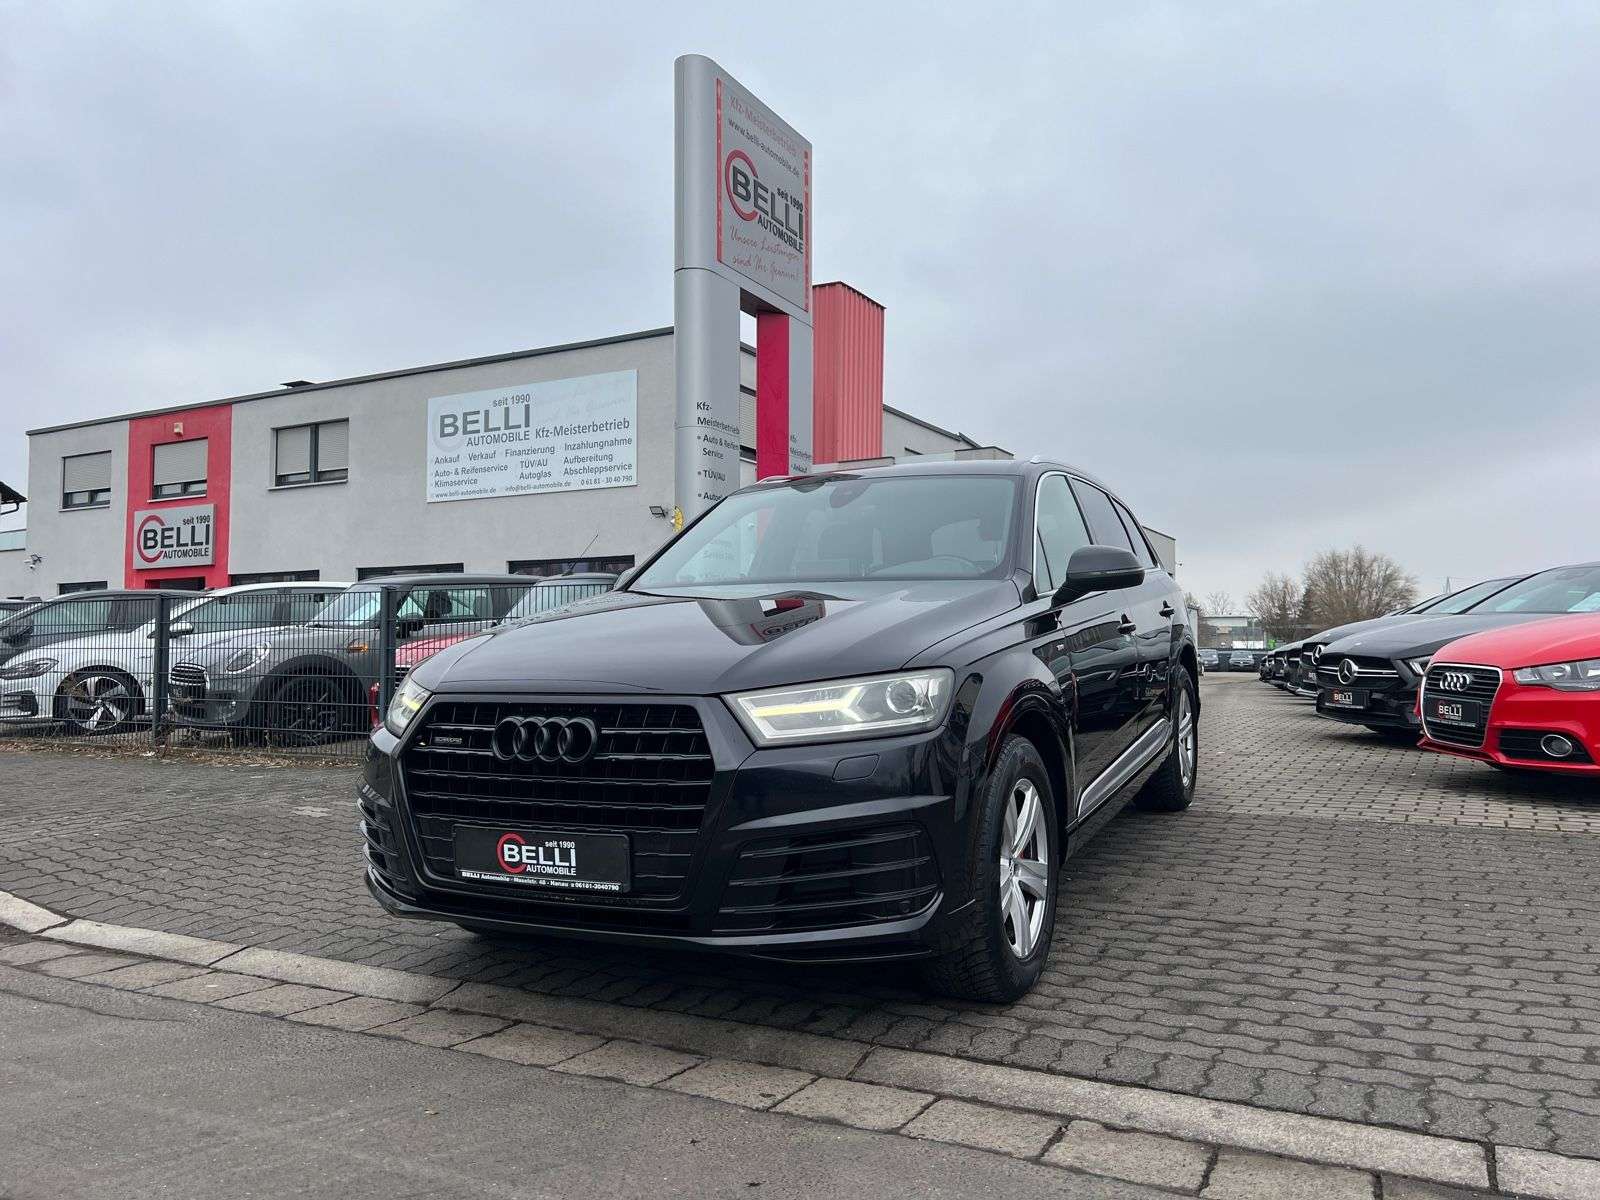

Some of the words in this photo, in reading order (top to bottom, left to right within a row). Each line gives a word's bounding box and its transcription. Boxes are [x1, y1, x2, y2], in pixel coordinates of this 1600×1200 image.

[732, 165, 804, 241] BELLI
[777, 187, 789, 202] seit
[789, 195, 804, 212] 1990
[757, 214, 804, 255] AUTOMOBILE
[493, 397, 508, 408] seit
[511, 393, 530, 405] 1990
[696, 401, 712, 411] Kfz-
[439, 404, 530, 438] BELLI
[697, 416, 740, 435] Meisterbetrieb
[535, 418, 630, 440] Kfz-Meisterbetrieb
[466, 430, 530, 447] AUTOMOBILE
[702, 434, 718, 444] Auto
[434, 455, 460, 465] Ankauf
[468, 451, 497, 461] Verkauf
[505, 445, 555, 458] Finanzierung
[564, 437, 633, 452] Inzahlungnahme
[702, 448, 724, 459] Service
[563, 453, 614, 465] Aufbereitung
[434, 468, 453, 478] Auto-
[454, 467, 460, 476] &
[461, 463, 508, 476] Reifenservice
[519, 471, 552, 483] Autoglas
[563, 463, 633, 478] Abschleppservice
[434, 477, 478, 488] Klimaservice
[435, 486, 497, 499] www.belli-automobile.de
[183, 517, 194, 525] seit
[196, 515, 210, 524] 1990
[143, 524, 210, 550] BELLI
[163, 547, 209, 559] AUTOMOBILE
[1438, 705, 1462, 717] BELLI
[545, 840, 558, 848] seit
[559, 840, 575, 849] 1990
[503, 844, 577, 867] BELLI
[526, 865, 577, 876] AUTOMOBILE
